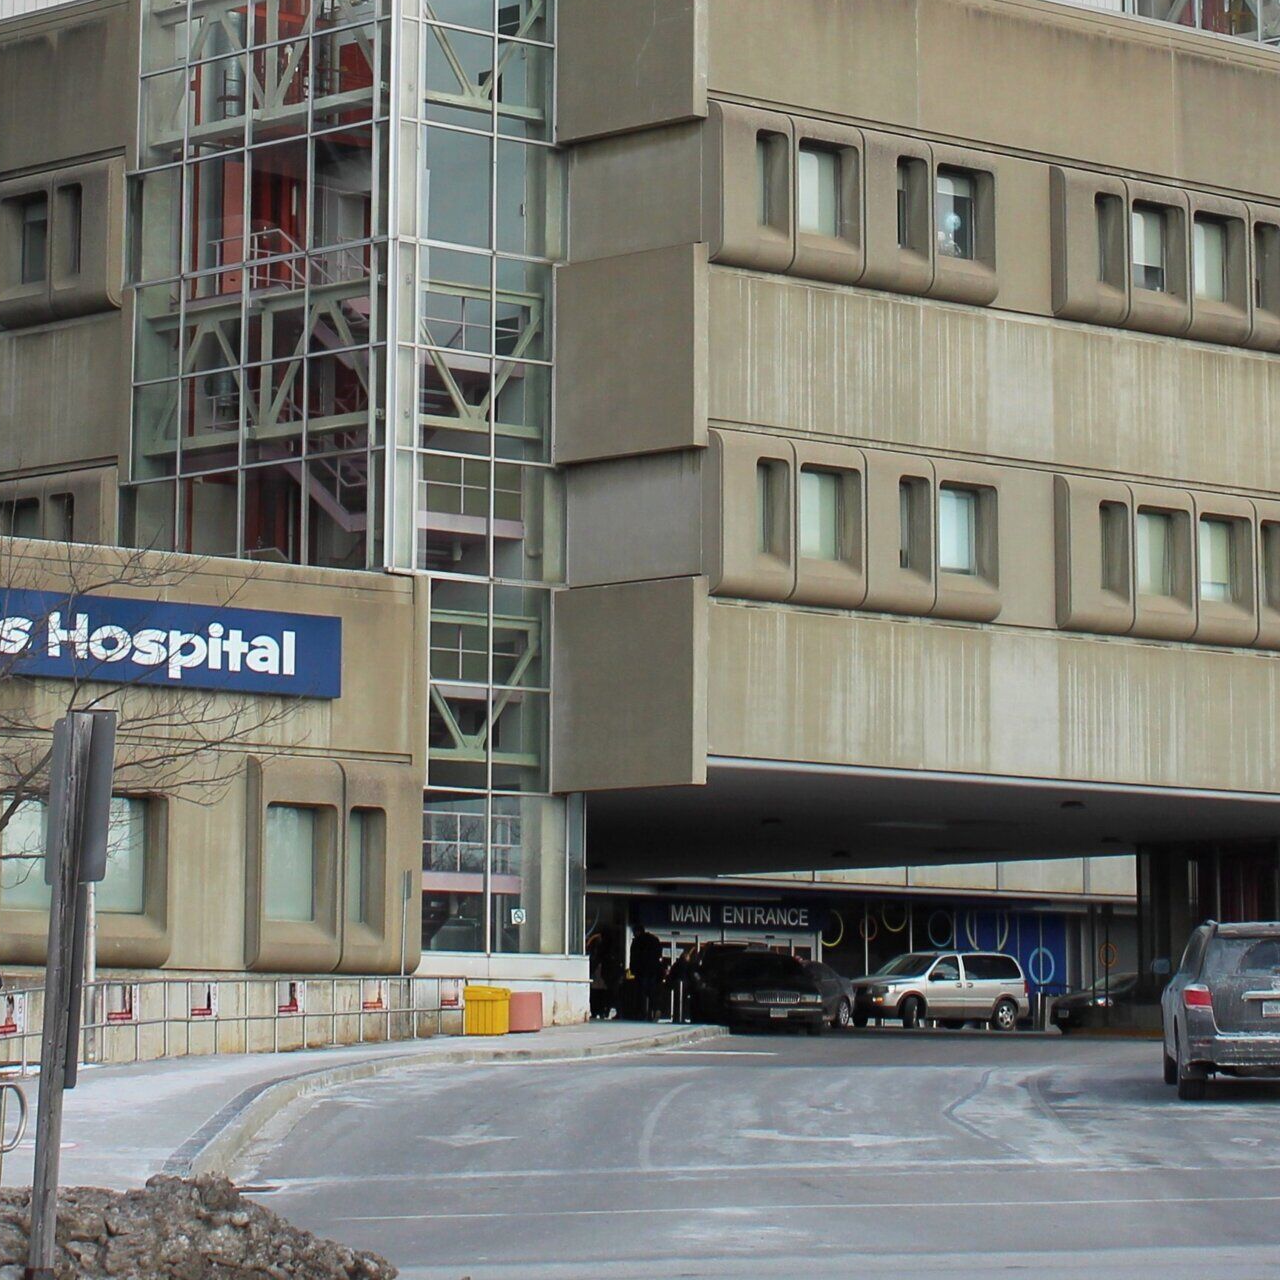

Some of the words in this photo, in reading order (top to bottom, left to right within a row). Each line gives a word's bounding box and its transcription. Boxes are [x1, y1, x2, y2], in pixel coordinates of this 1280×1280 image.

[48, 611, 296, 679] Hospital
[670, 904, 711, 923] MAIN
[723, 906, 809, 926] ENTRANCE
